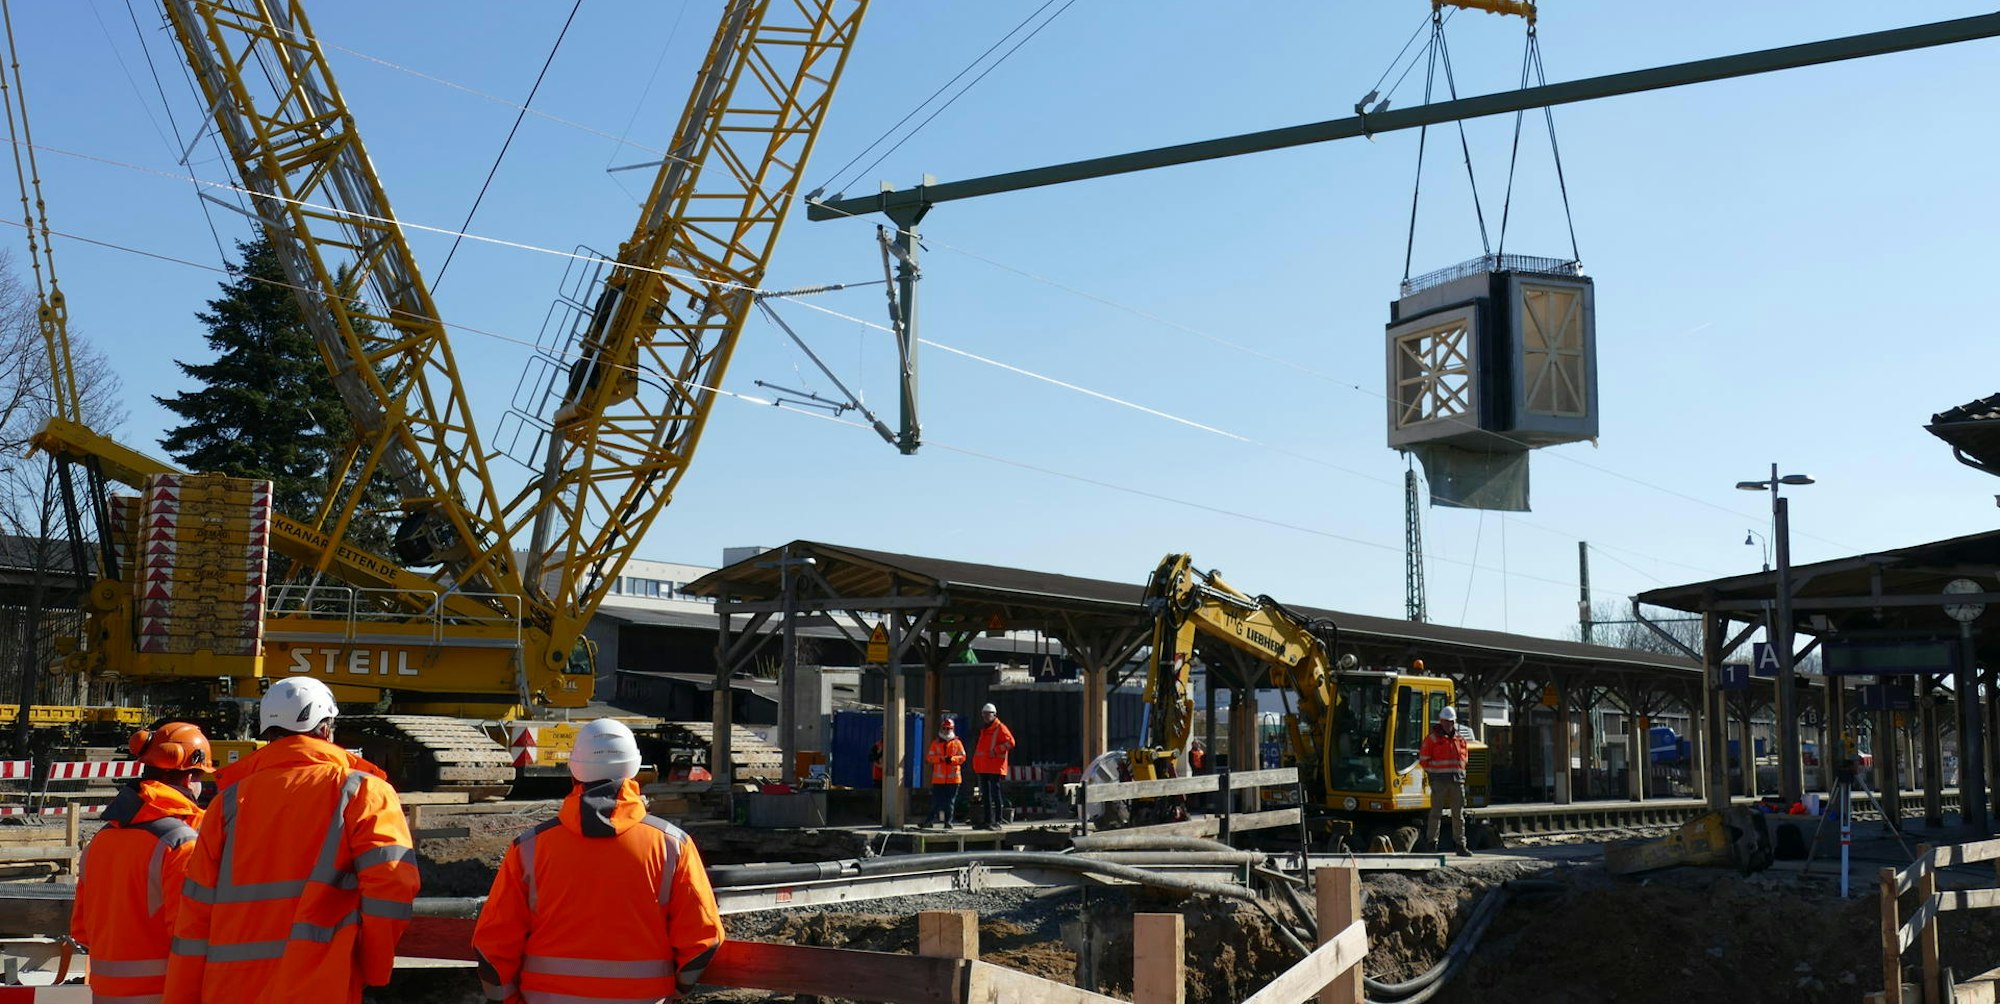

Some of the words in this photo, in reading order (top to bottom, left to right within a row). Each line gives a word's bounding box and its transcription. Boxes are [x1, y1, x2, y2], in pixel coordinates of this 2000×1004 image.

[1247, 627, 1286, 657] LIEBHERR
[289, 647, 418, 675] STEIL
[1041, 655, 1055, 676] A
[1760, 643, 1780, 669] A
[1726, 667, 1735, 683] 1
[1858, 686, 1868, 705] 1
